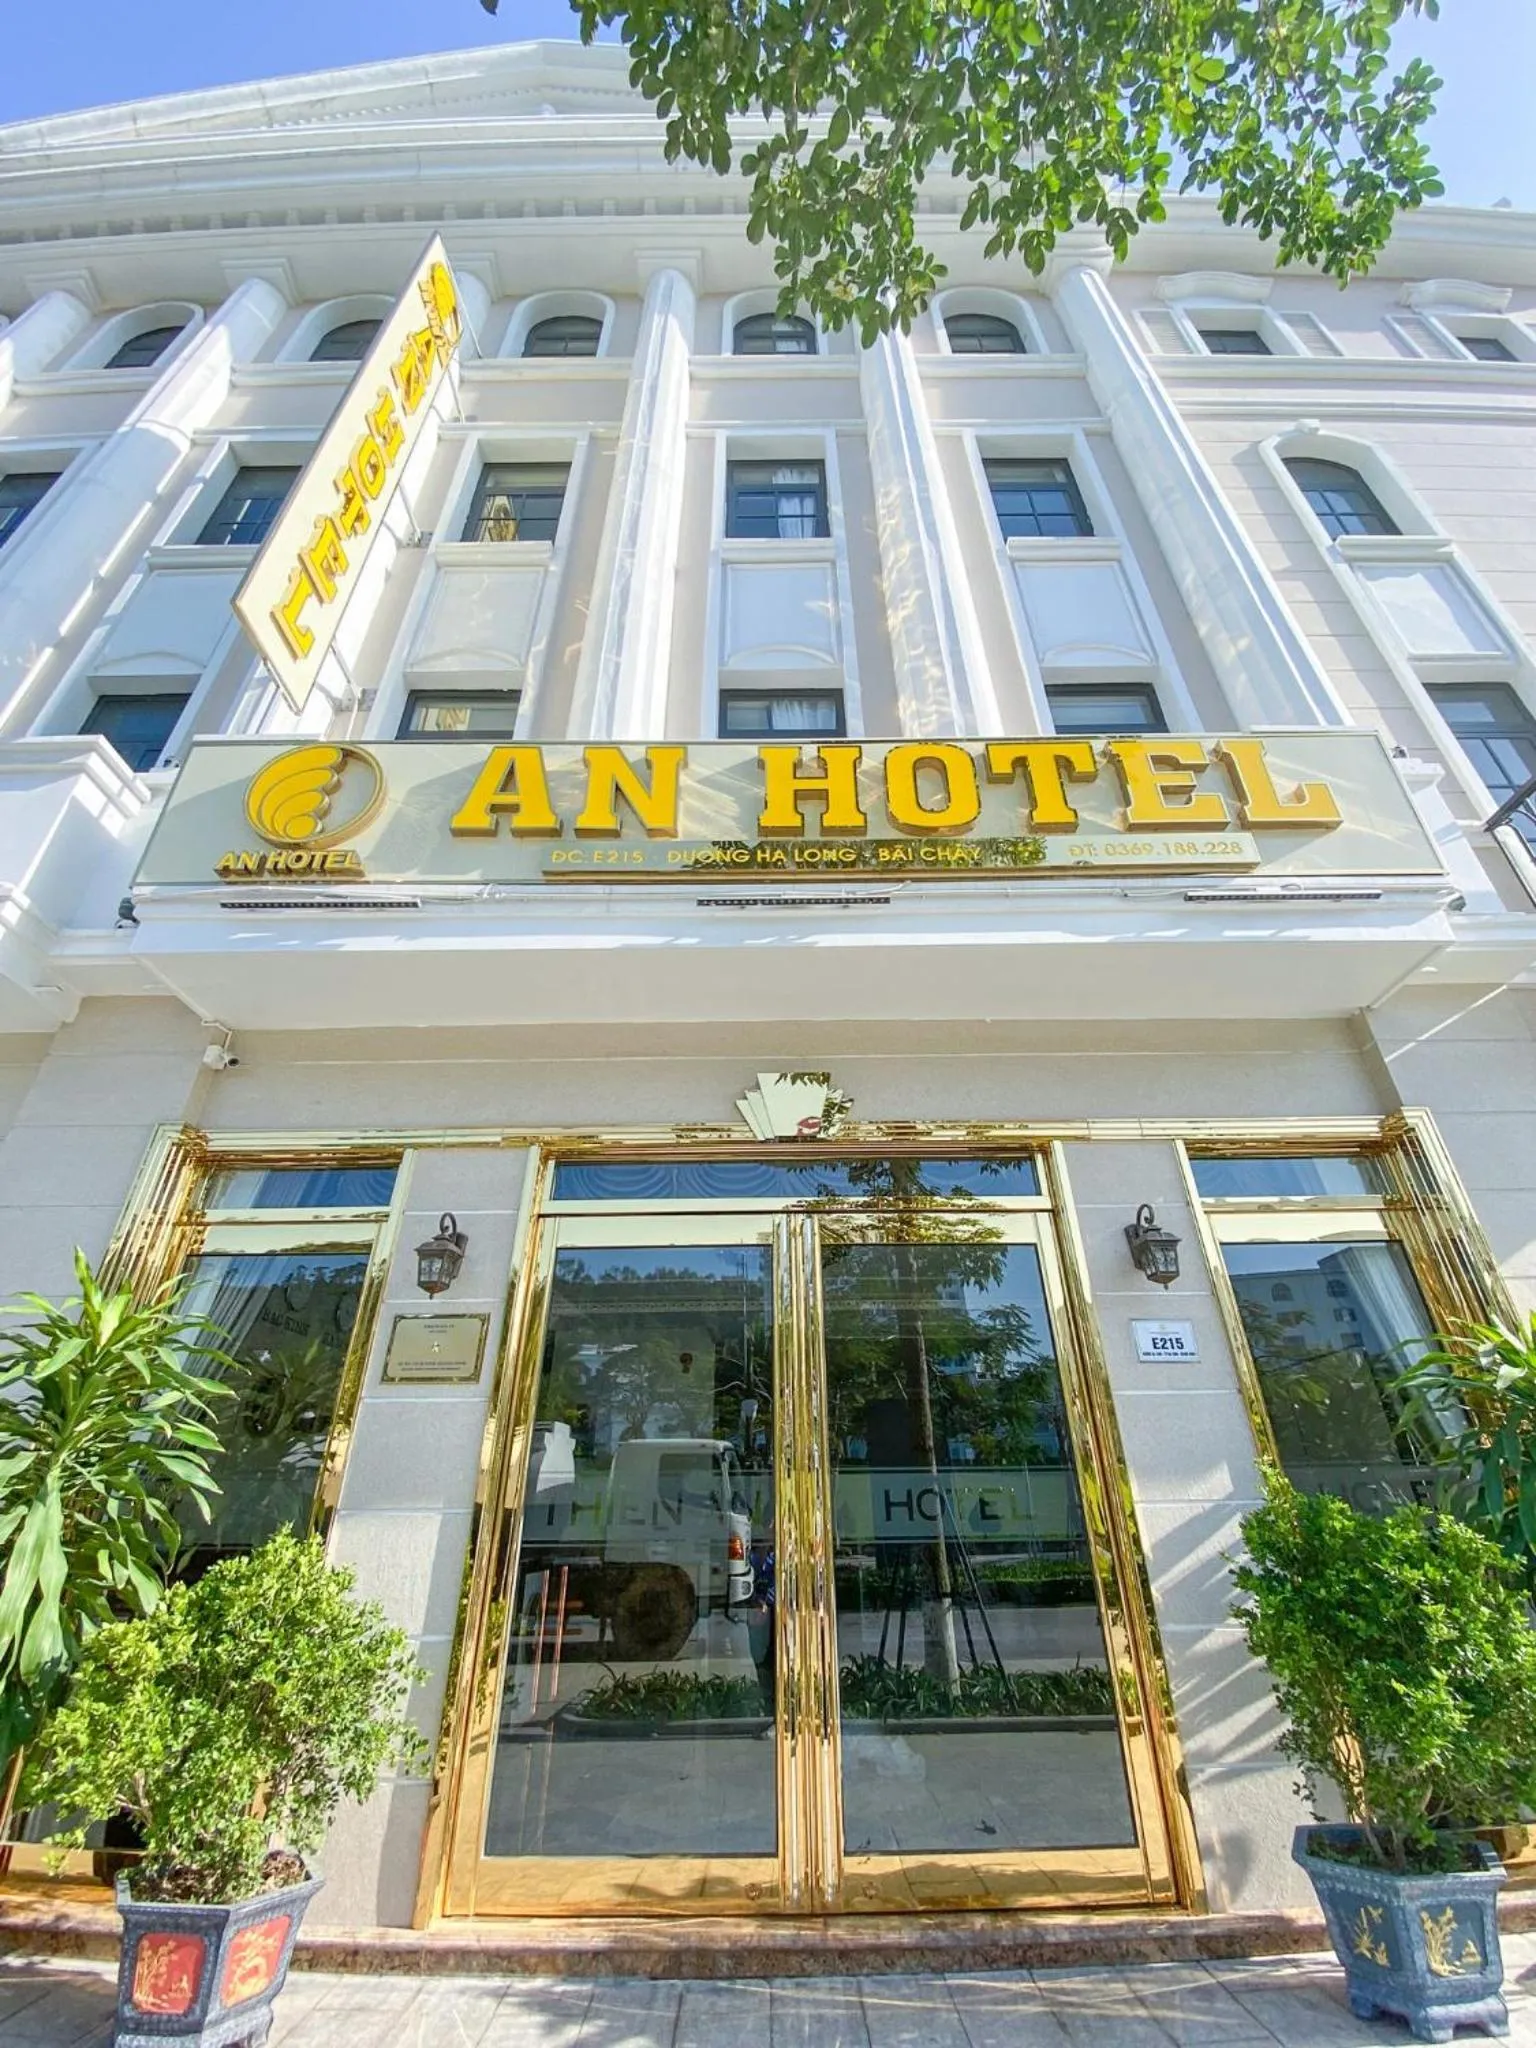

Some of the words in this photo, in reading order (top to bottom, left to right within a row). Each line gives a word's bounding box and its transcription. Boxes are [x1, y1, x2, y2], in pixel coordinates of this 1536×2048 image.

[271, 385, 405, 663] HOTEL
[450, 745, 687, 836] AN
[757, 740, 1343, 834] HOTEL
[214, 851, 263, 874] AN
[265, 850, 364, 874] HOTEL
[794, 848, 857, 862] LONG
[1104, 841, 1243, 857] 0369.188.228
[1152, 1337, 1185, 1350] E215
